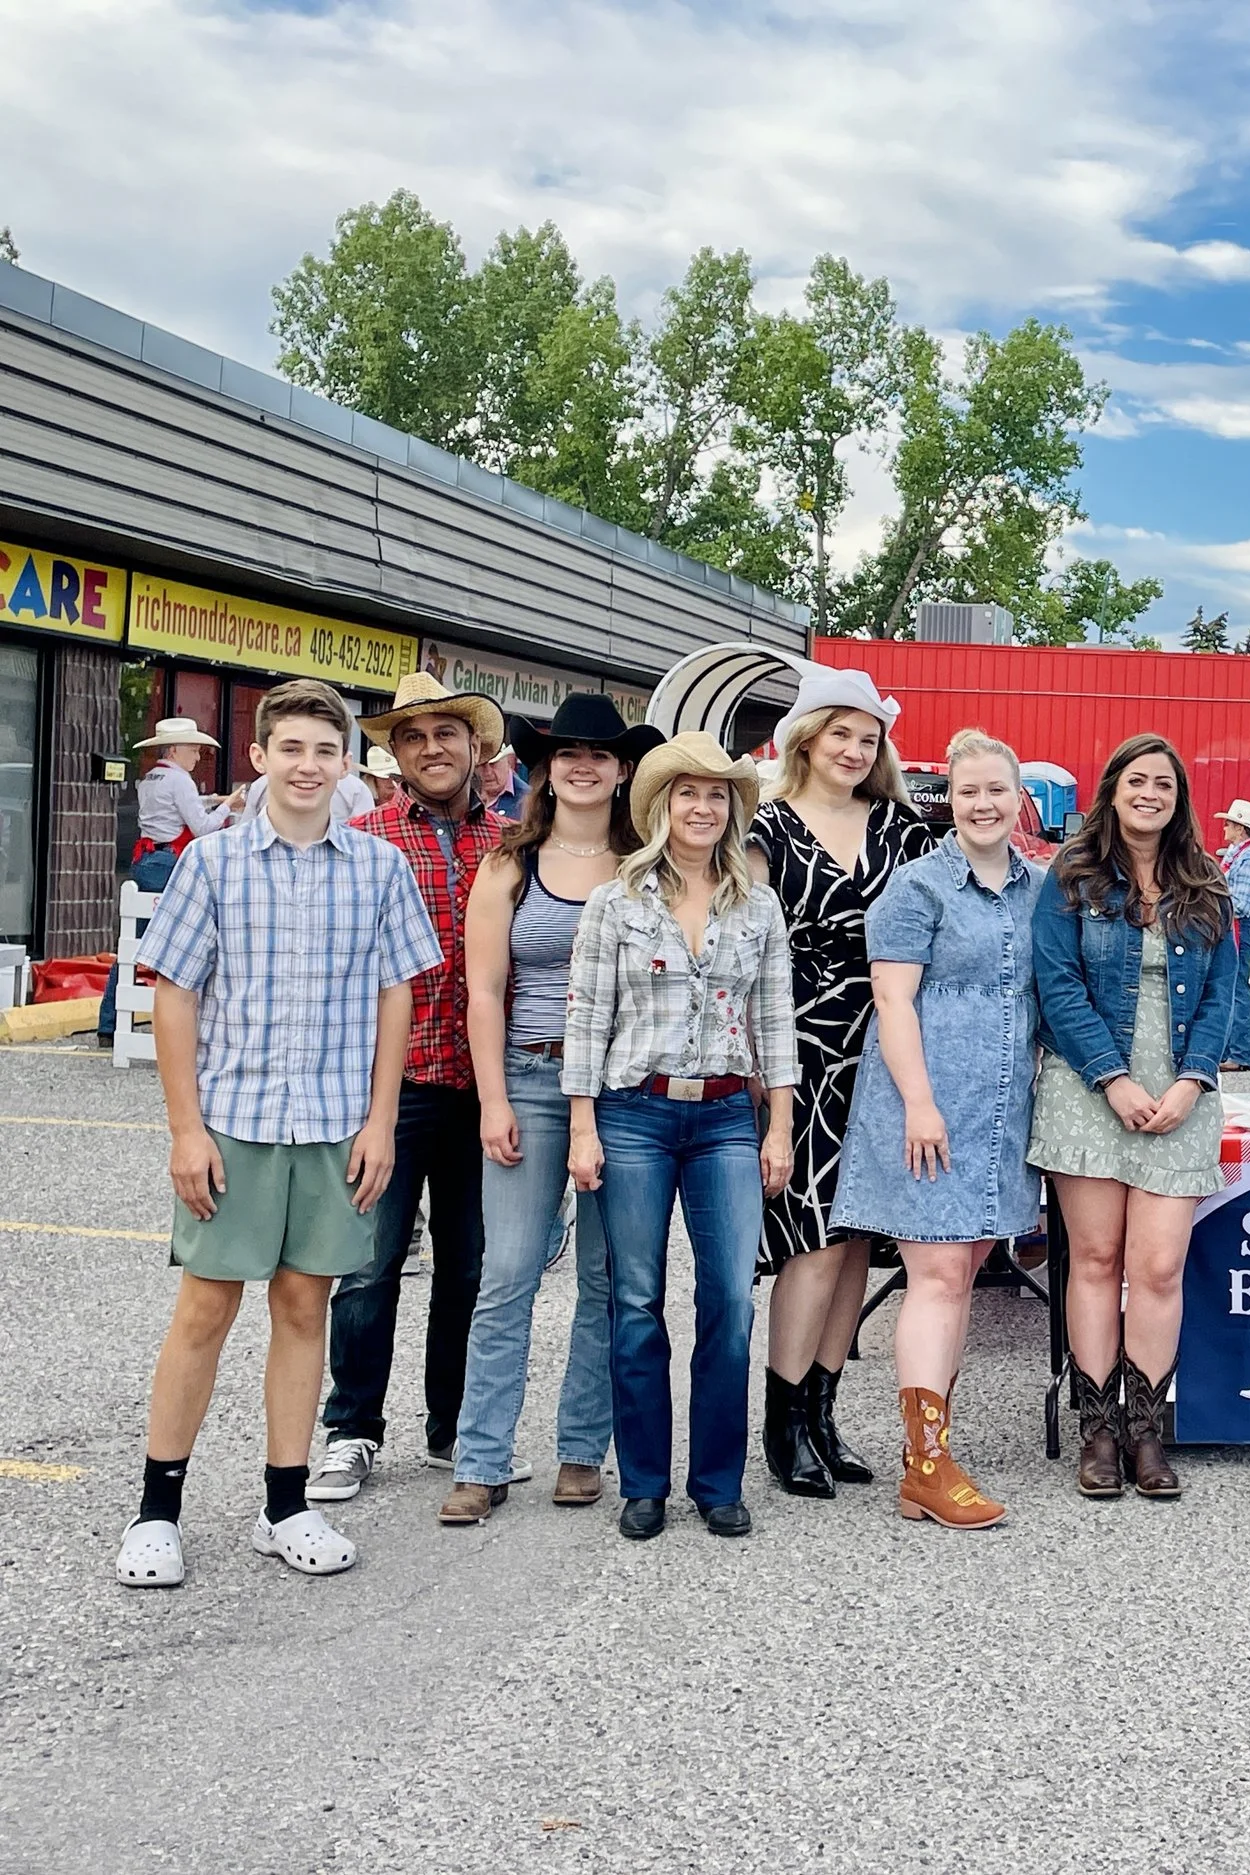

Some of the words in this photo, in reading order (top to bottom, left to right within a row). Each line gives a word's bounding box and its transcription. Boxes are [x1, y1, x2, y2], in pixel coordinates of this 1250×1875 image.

[0, 551, 108, 630] ARE
[136, 584, 301, 657] richmonddaycare.ca
[309, 627, 395, 678] 403-452-2922
[452, 659, 509, 700] Calgary
[511, 672, 548, 705] Avian
[552, 680, 562, 708] &
[627, 696, 647, 723] Clin
[913, 792, 950, 804] COMM
